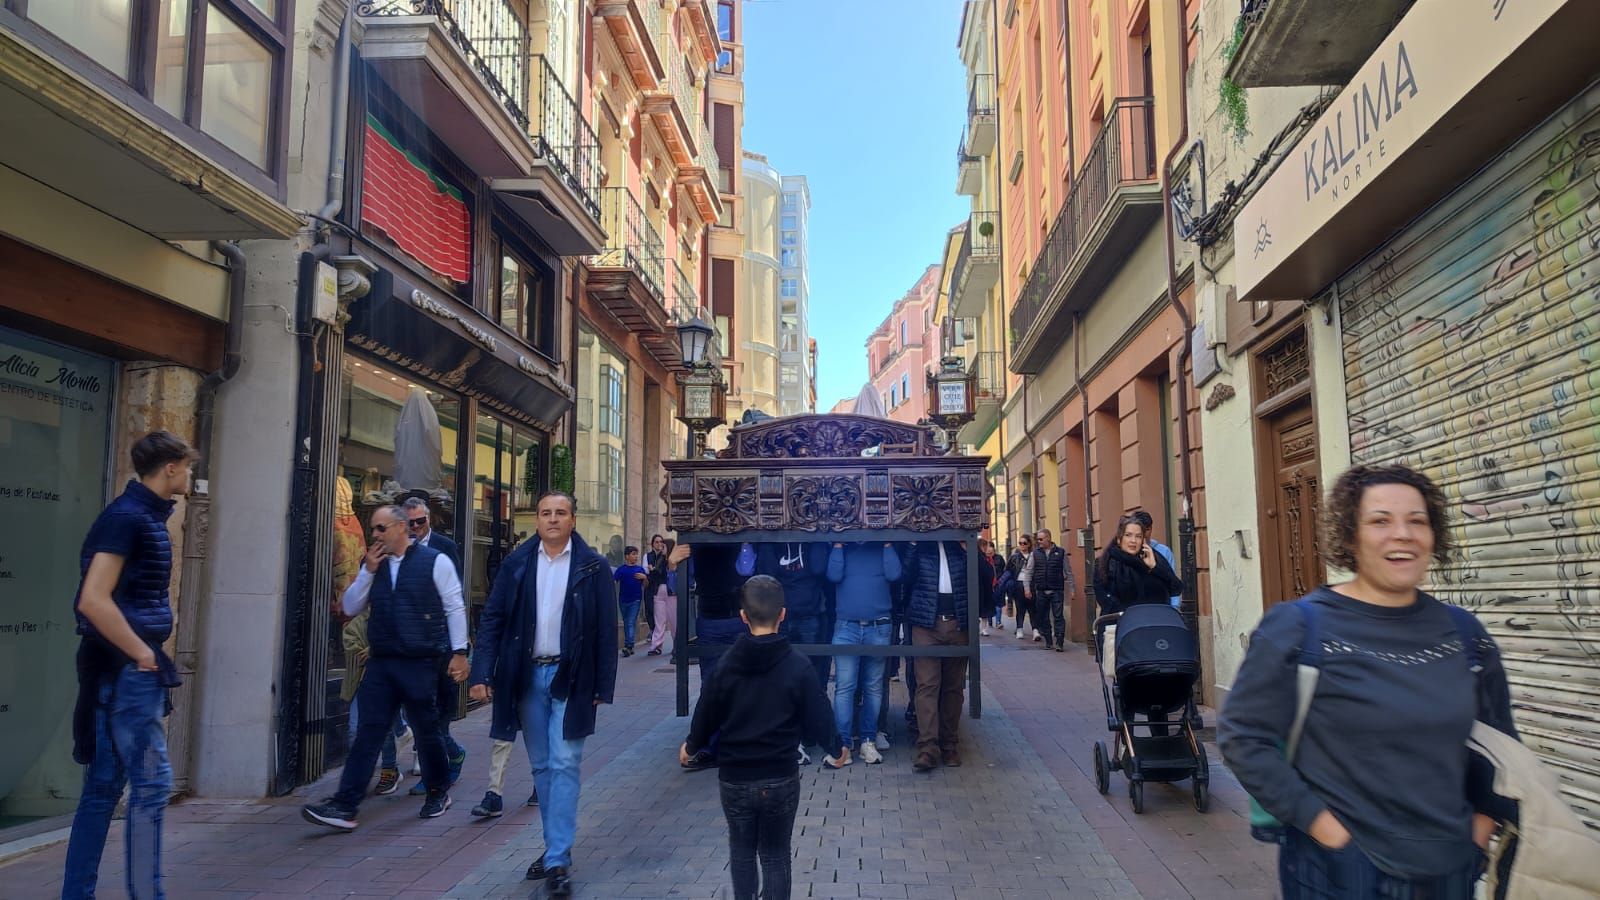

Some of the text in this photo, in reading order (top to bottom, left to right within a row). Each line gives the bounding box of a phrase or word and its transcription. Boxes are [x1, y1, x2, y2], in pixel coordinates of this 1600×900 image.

[1304, 40, 1418, 202] KALIMA
[1332, 139, 1386, 201] NORTE
[0, 354, 101, 393] Alicia Morillo
[0, 383, 34, 398] ENTRO
[37, 391, 49, 402] DE
